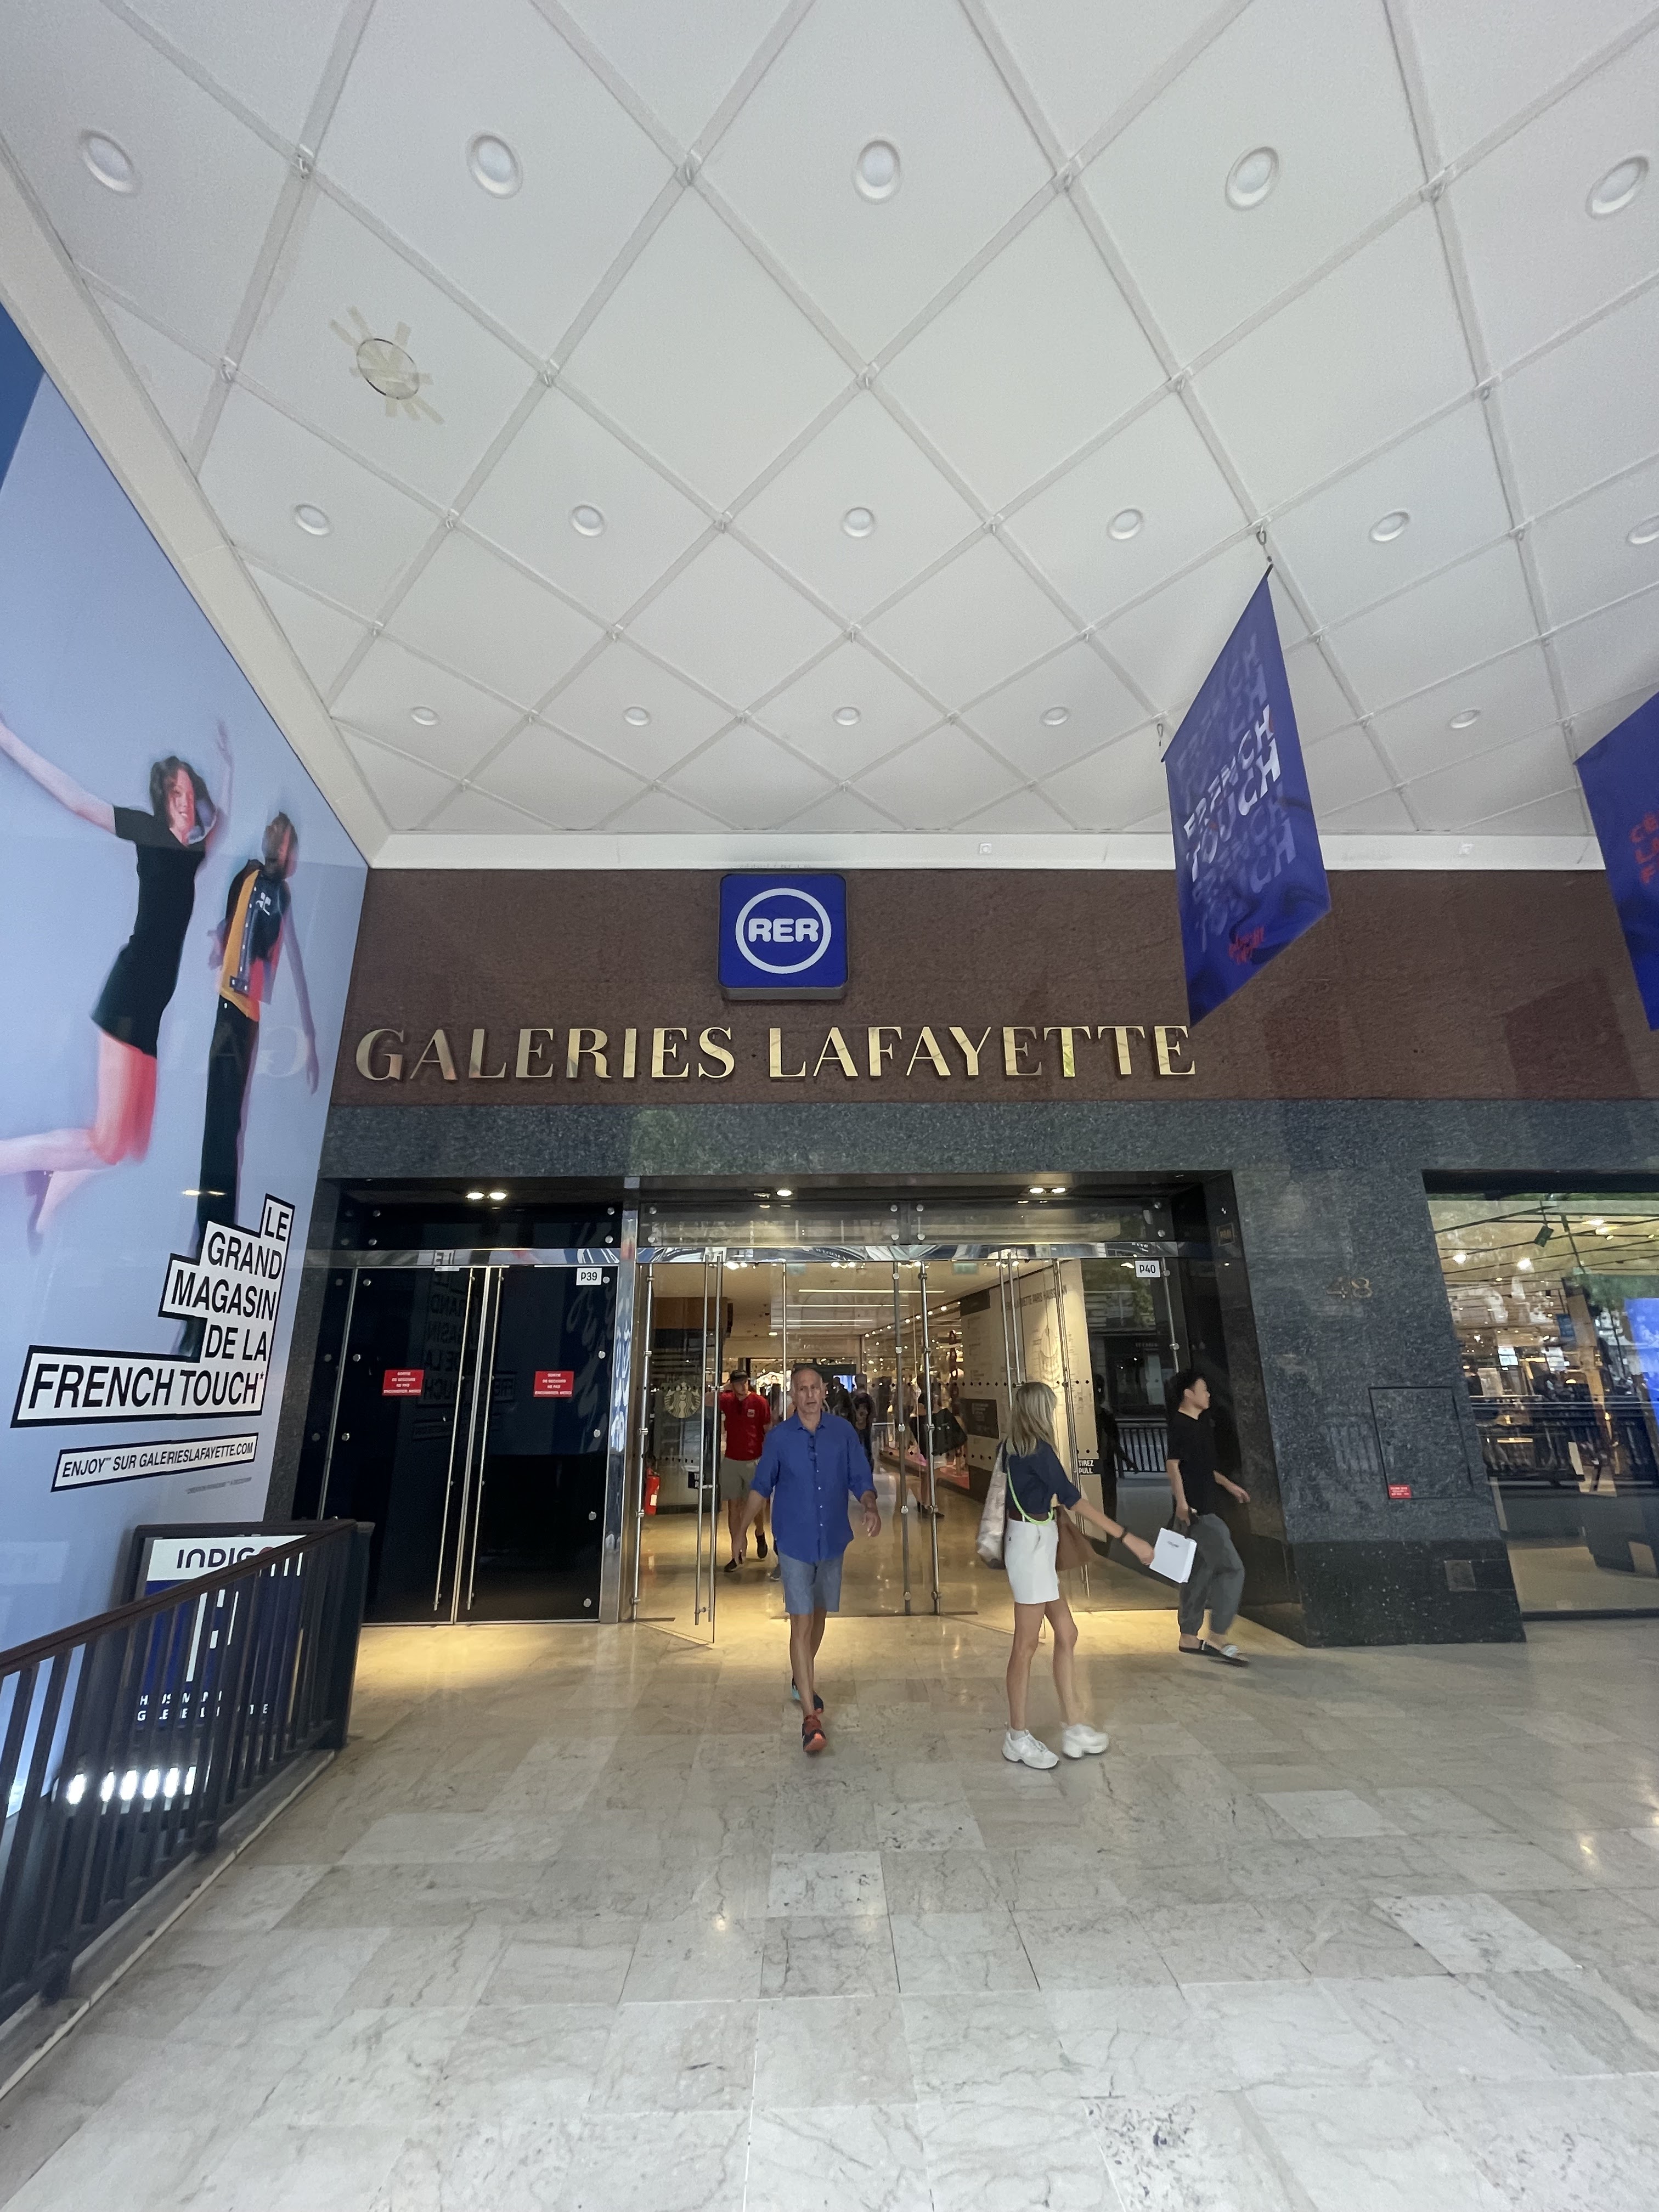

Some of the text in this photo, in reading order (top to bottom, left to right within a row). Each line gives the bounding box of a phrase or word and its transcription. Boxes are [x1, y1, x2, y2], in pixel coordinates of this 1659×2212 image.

[748, 918, 819, 943] RER
[355, 1025, 1196, 1081] GALERIES LAFAYETTE
[264, 1206, 289, 1242] LE
[208, 1231, 283, 1280] GRAND
[1139, 1264, 1156, 1274] P40
[580, 1272, 597, 1281] P39
[171, 1269, 276, 1321] MAGASIN
[205, 1324, 267, 1361] DE LA
[28, 1363, 175, 1409] FRENCH
[113, 1454, 137, 1471] SUR
[139, 1442, 254, 1468] GALERIESLAFAYETTE.COM
[176, 1546, 274, 1568] INDIG
